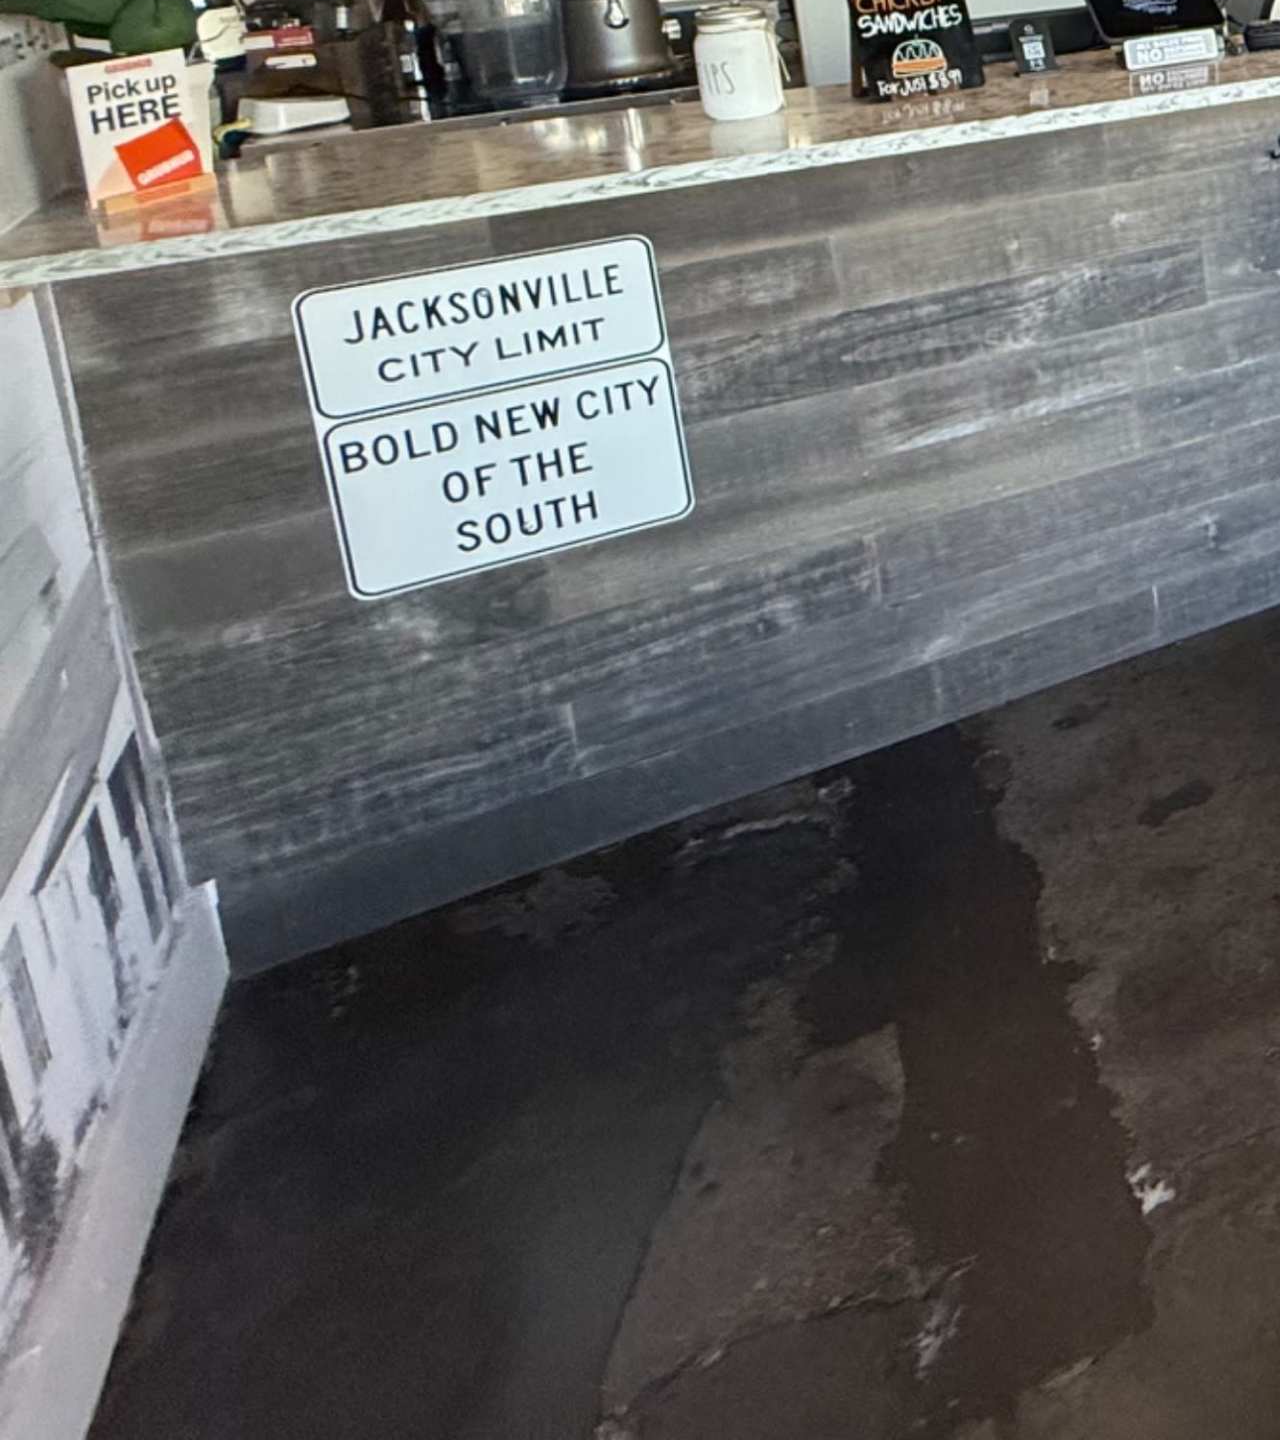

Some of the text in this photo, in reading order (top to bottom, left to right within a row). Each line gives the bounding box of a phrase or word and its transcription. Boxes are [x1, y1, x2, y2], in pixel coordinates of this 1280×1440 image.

[857, 4, 962, 38] SANDWICHES
[86, 74, 177, 104] Pick up
[90, 93, 182, 135] HERE
[343, 263, 624, 344] JACKSONVILLE
[377, 317, 605, 383] CITY LIMIT
[339, 376, 659, 474] BOLD NEW CITY
[442, 442, 593, 503] OF THE
[456, 490, 598, 553] SOUTH
